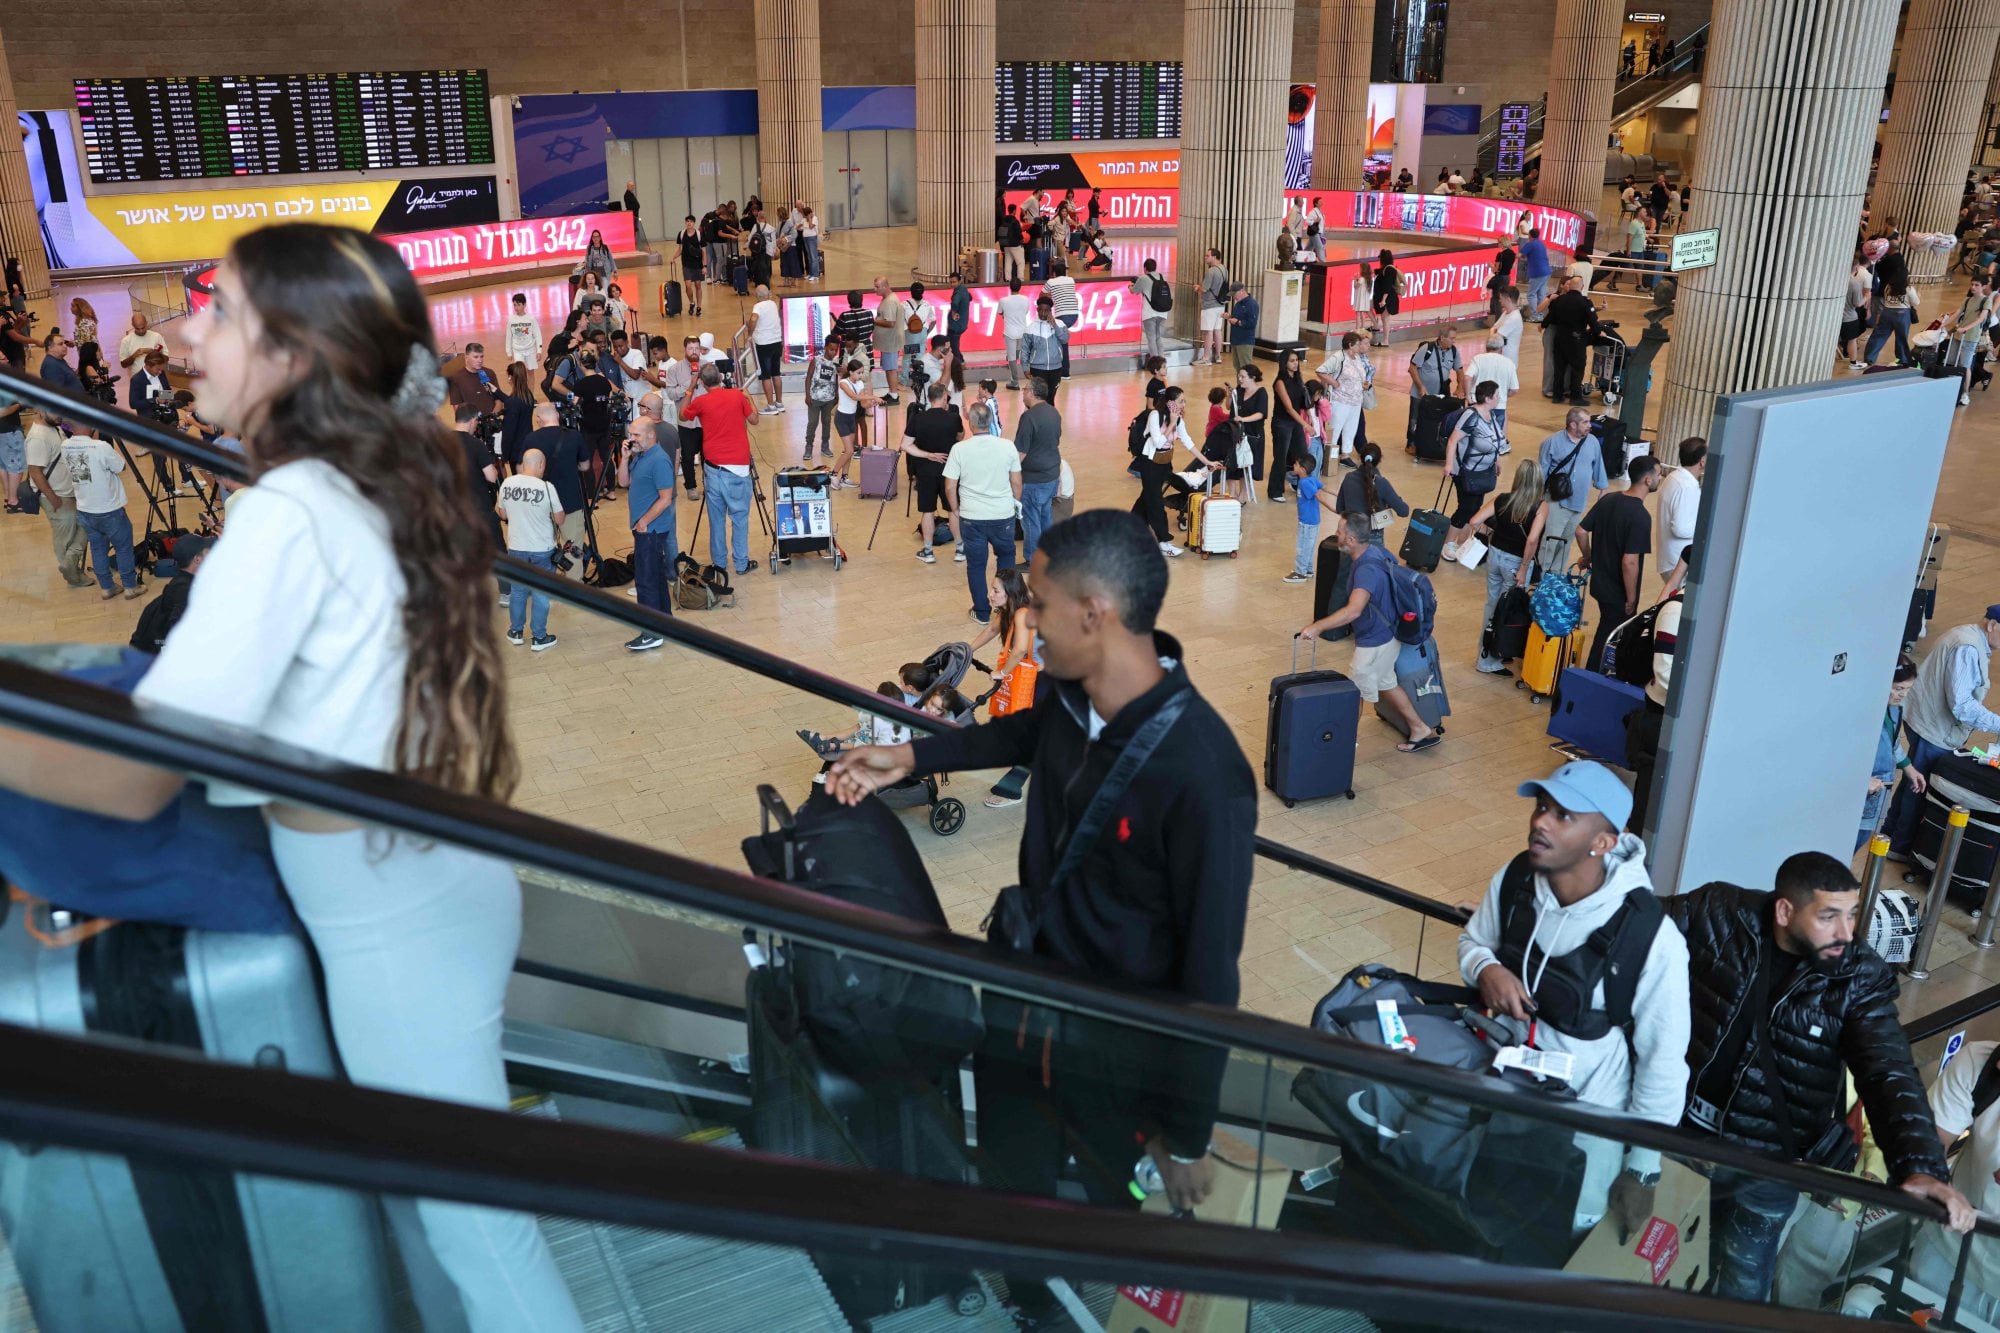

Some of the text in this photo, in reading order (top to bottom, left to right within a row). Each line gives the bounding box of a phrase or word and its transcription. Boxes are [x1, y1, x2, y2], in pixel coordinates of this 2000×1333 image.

[1098, 159, 1180, 175] כם את המחר
[116, 195, 372, 226] בונים לכם רגעים של אושר
[1111, 193, 1172, 219] החלום
[475, 224, 536, 261] מגדלי
[542, 218, 588, 254] 342
[1675, 245, 1714, 257] PROTECTED AREA
[1430, 264, 1457, 295] לכם
[503, 486, 544, 504] BOLD
[814, 506, 825, 515] 24
